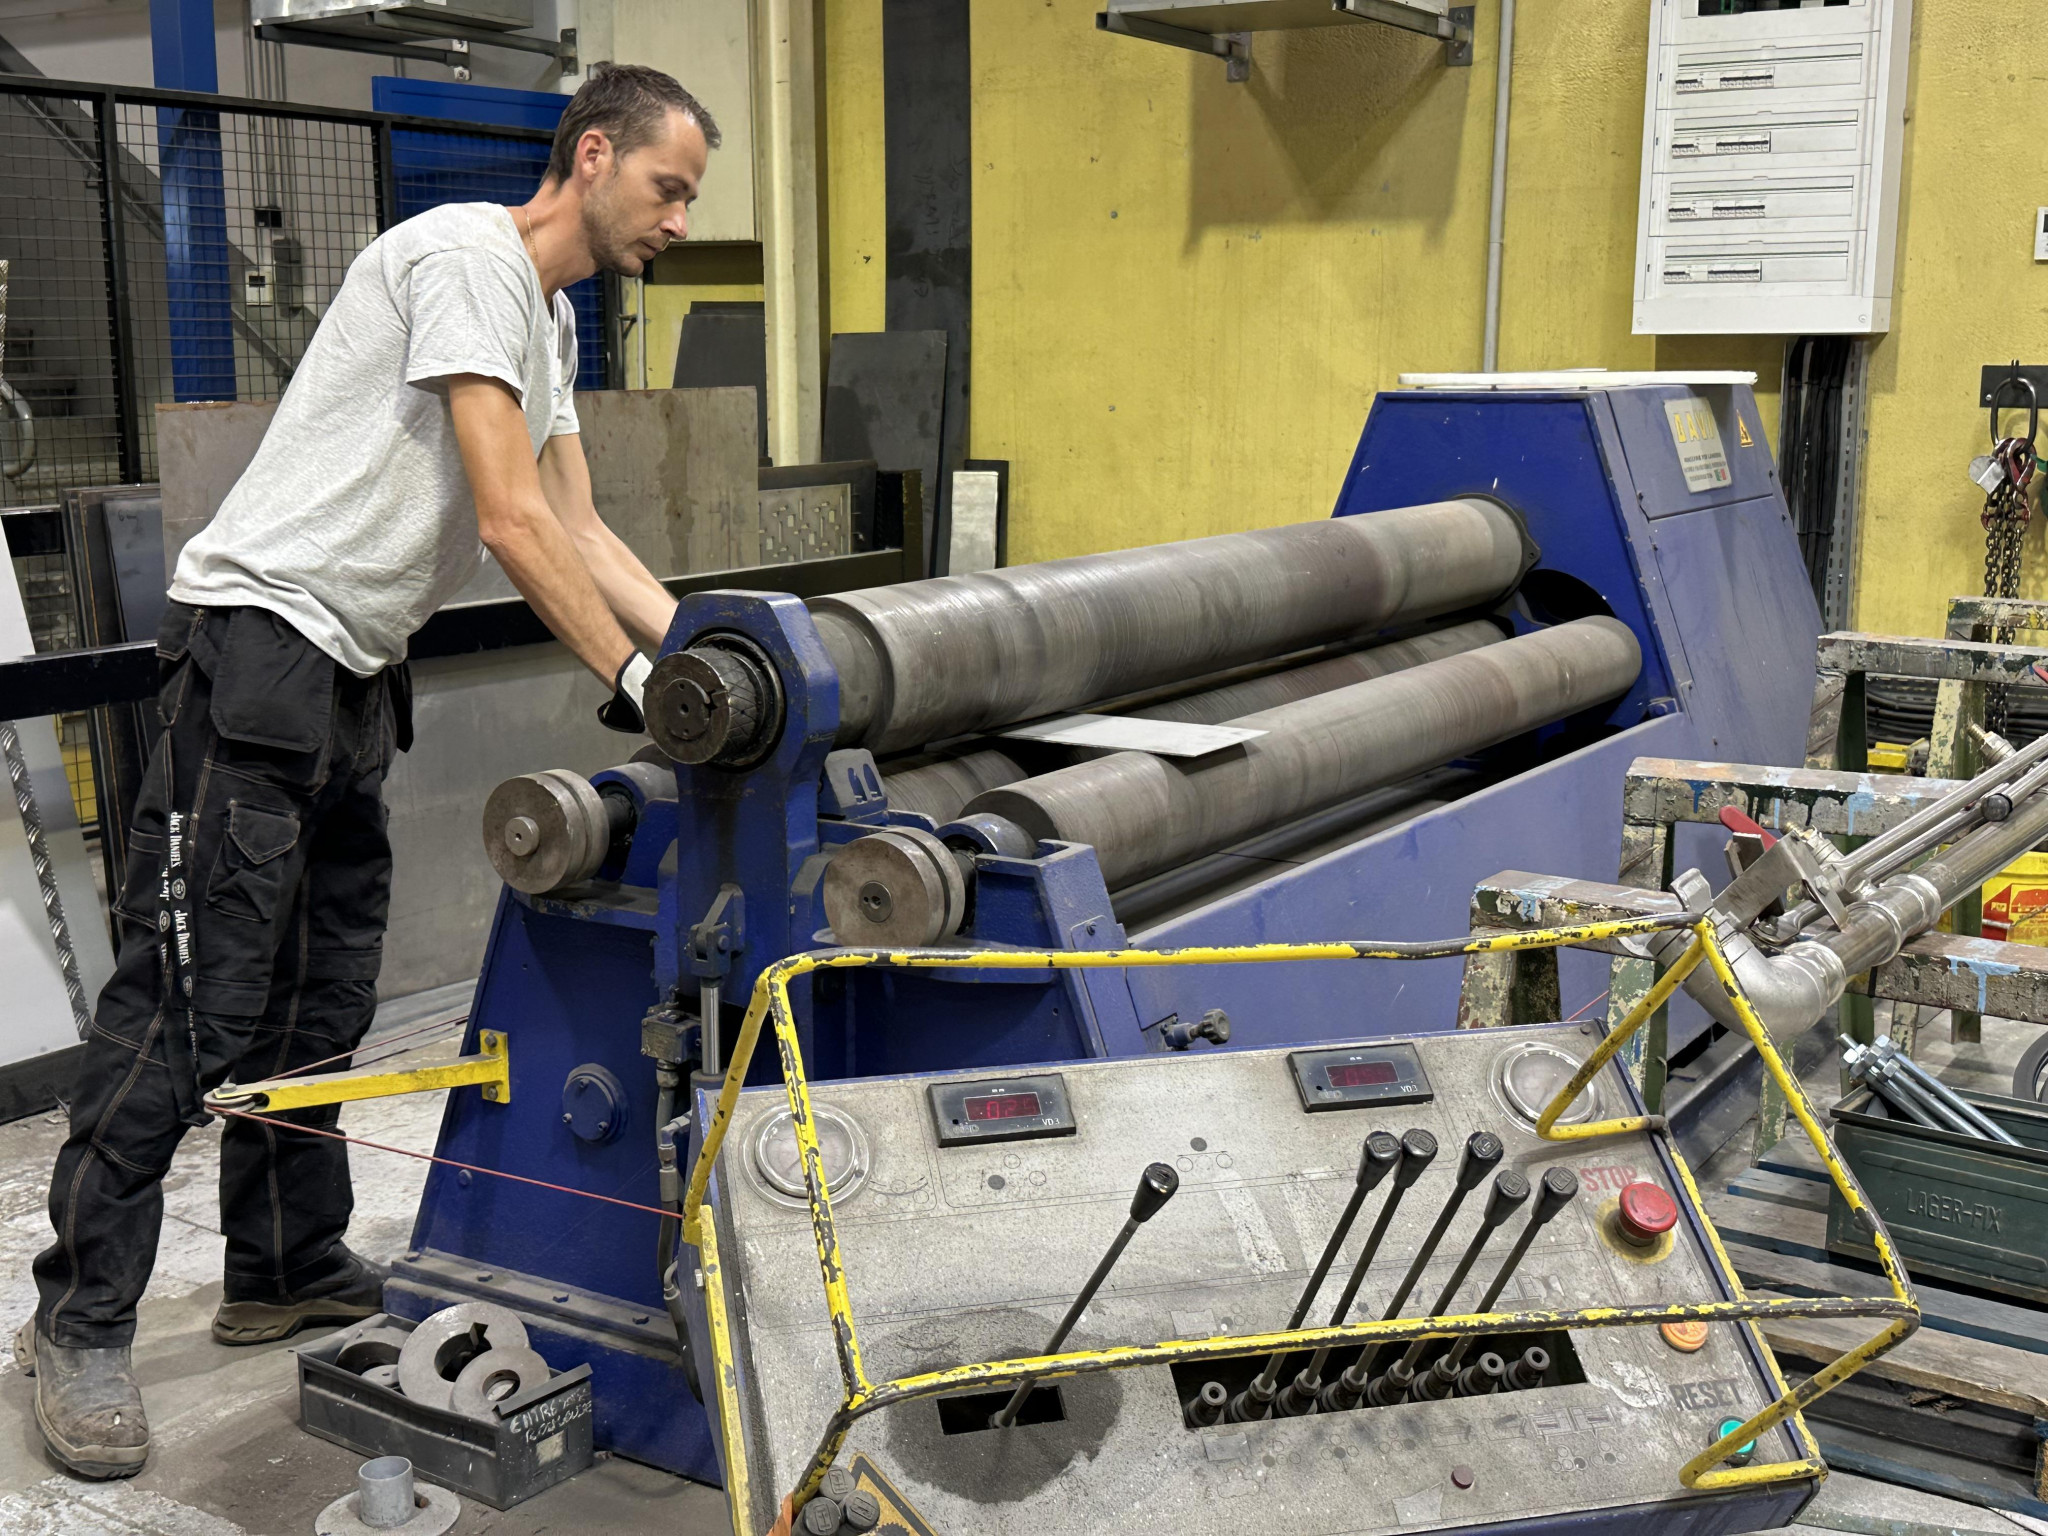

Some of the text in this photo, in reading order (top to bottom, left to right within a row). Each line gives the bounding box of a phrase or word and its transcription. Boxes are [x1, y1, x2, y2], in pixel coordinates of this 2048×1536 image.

[1673, 411, 1715, 443] DAVI
[170, 812, 184, 868] JACK DANIEL'S
[175, 910, 192, 966] JACK DANIEL'S
[1580, 1165, 1637, 1192] STOP
[1907, 1187, 2003, 1234] LAGER-FIX
[1669, 1378, 1742, 1412] RESET
